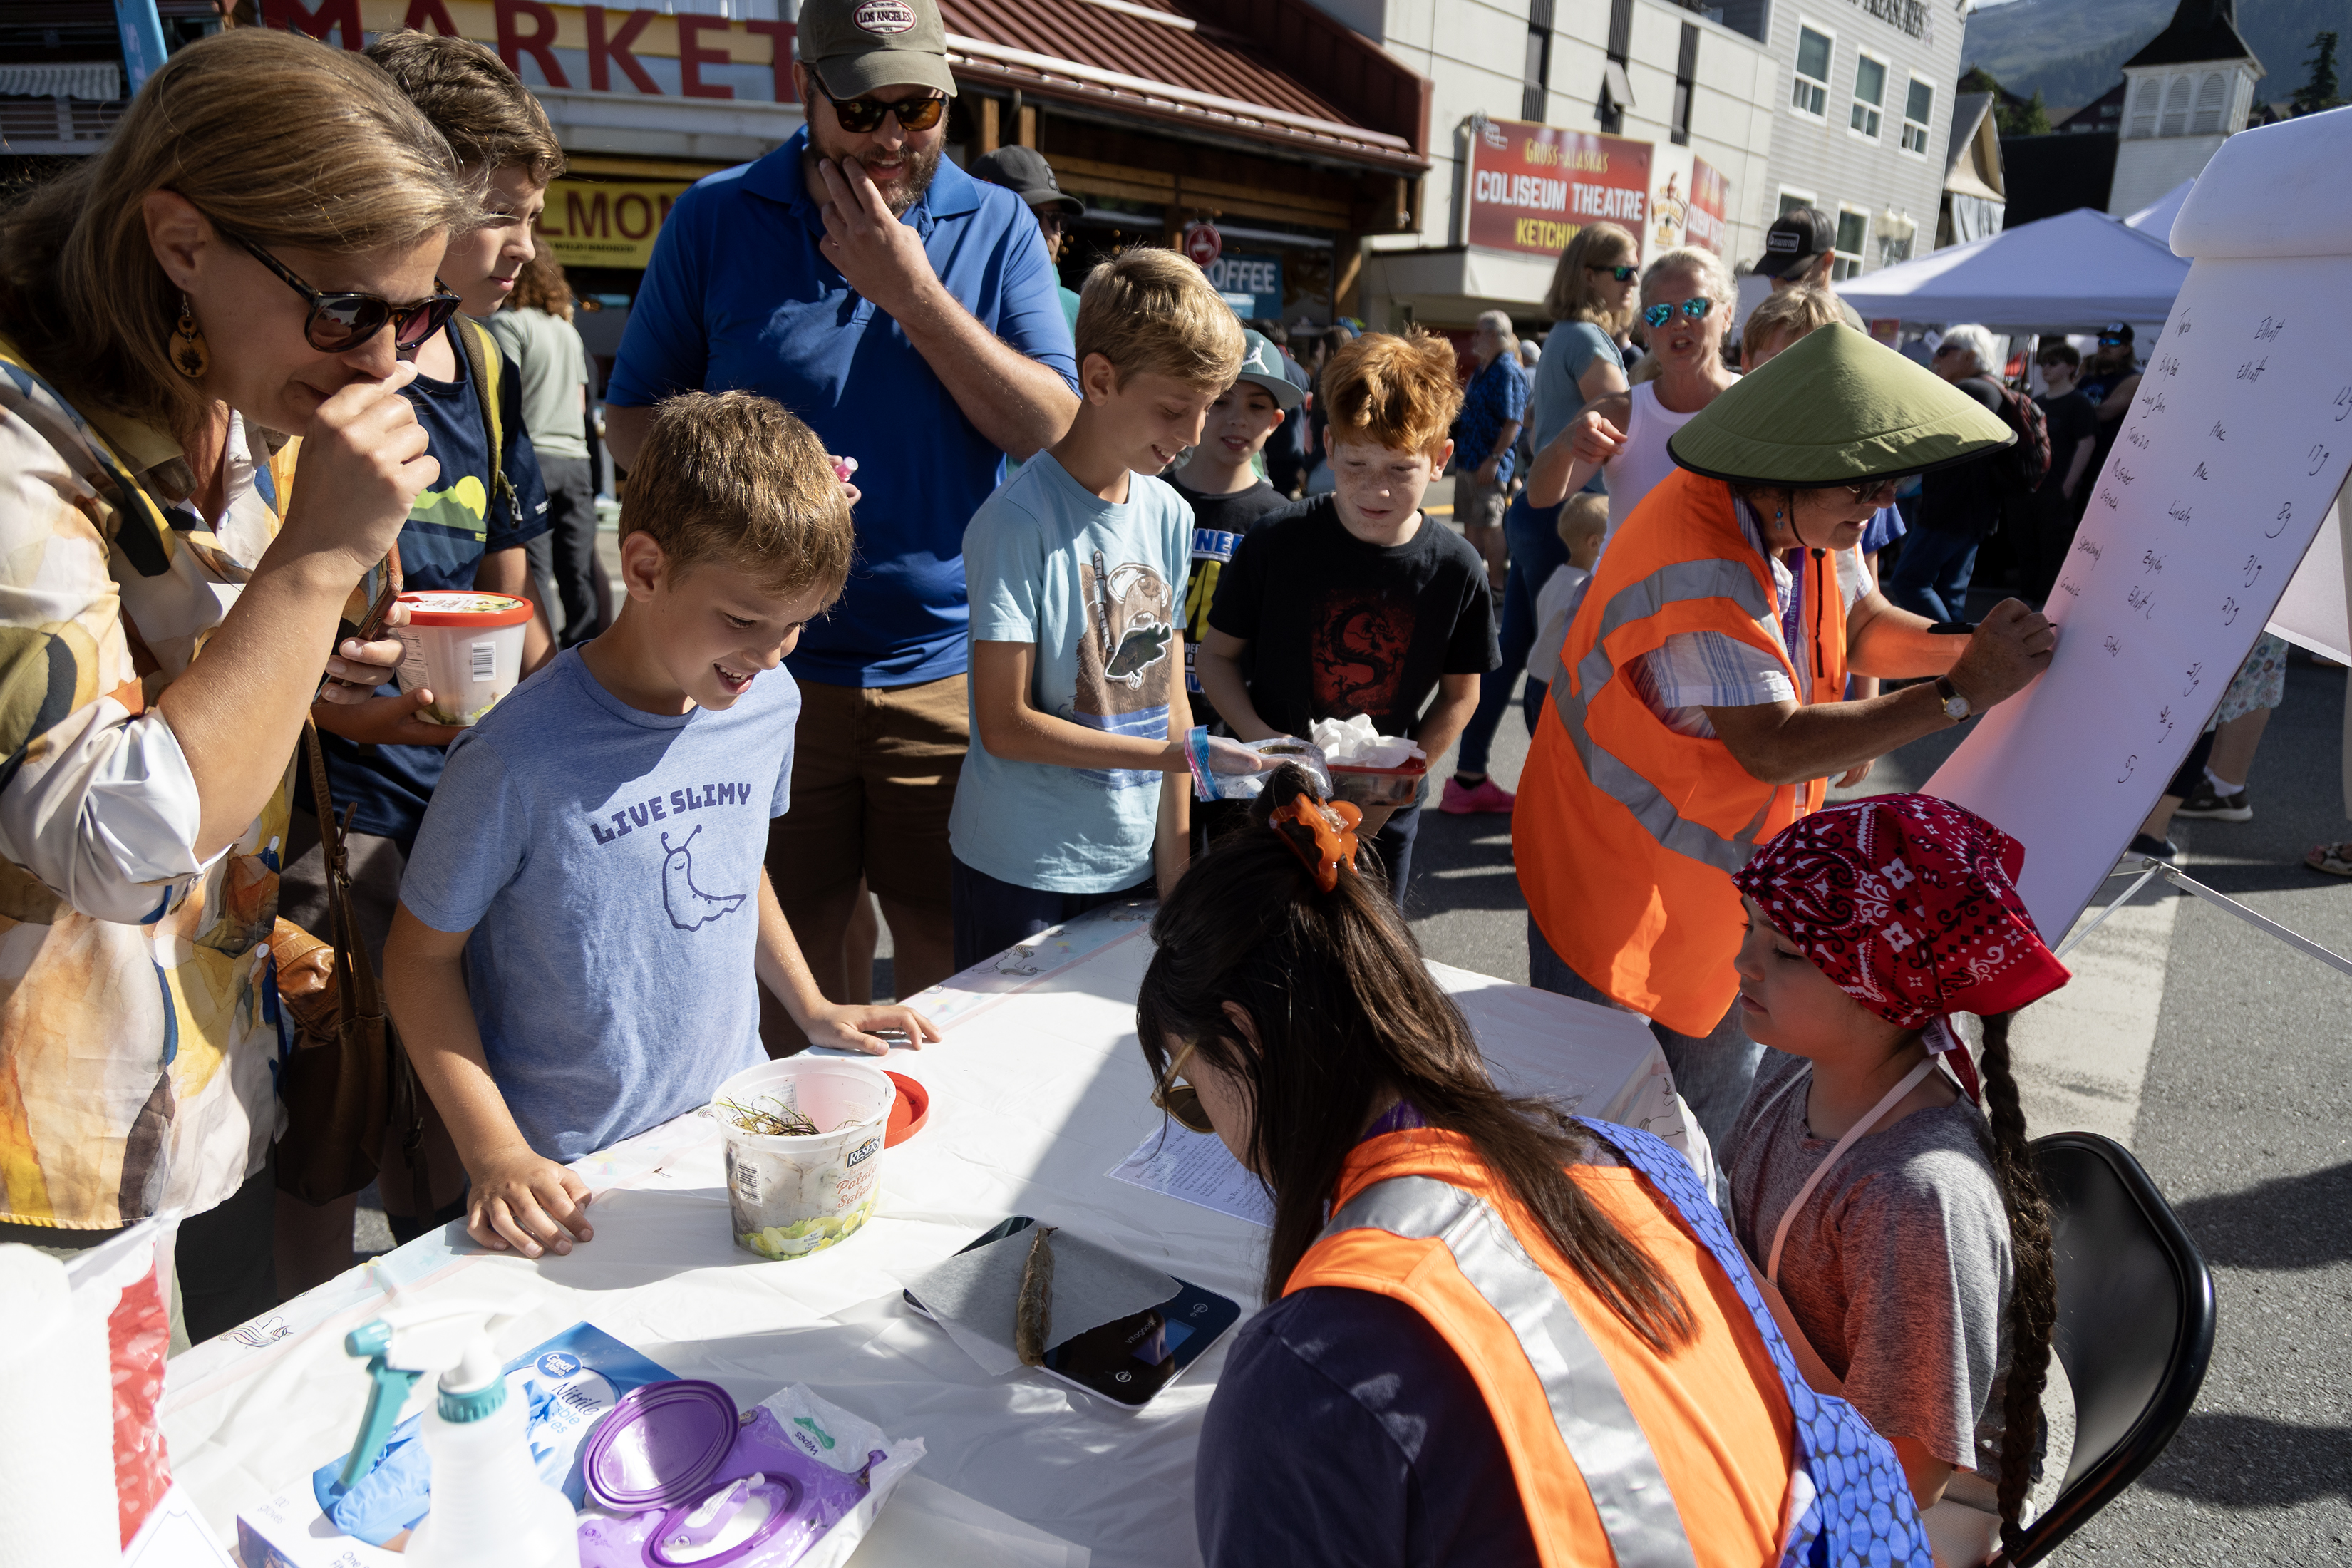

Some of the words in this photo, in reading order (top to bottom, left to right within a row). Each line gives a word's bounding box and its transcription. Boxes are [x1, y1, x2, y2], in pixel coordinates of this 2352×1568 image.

[860, 12, 875, 23] LOS
[877, 11, 912, 22] ANGELES
[1475, 170, 1568, 212] COLISEUM
[1572, 182, 1646, 221] THEATRE
[1207, 257, 1276, 295] OFFEE
[1192, 527, 1244, 557] NE
[1790, 569, 1800, 603] Festival
[1788, 604, 1797, 623] Arts
[590, 796, 666, 845] LIVE
[670, 783, 751, 815] SLIMY
[836, 1163, 877, 1195] Potato
[837, 1175, 875, 1209] Salad
[545, 1362, 566, 1376] Value
[546, 1353, 577, 1373] Great
[551, 1381, 602, 1416] Nitrile
[795, 1430, 819, 1456] Wipes
[257, 1504, 286, 1525] gloves
[274, 1495, 290, 1508] 100
